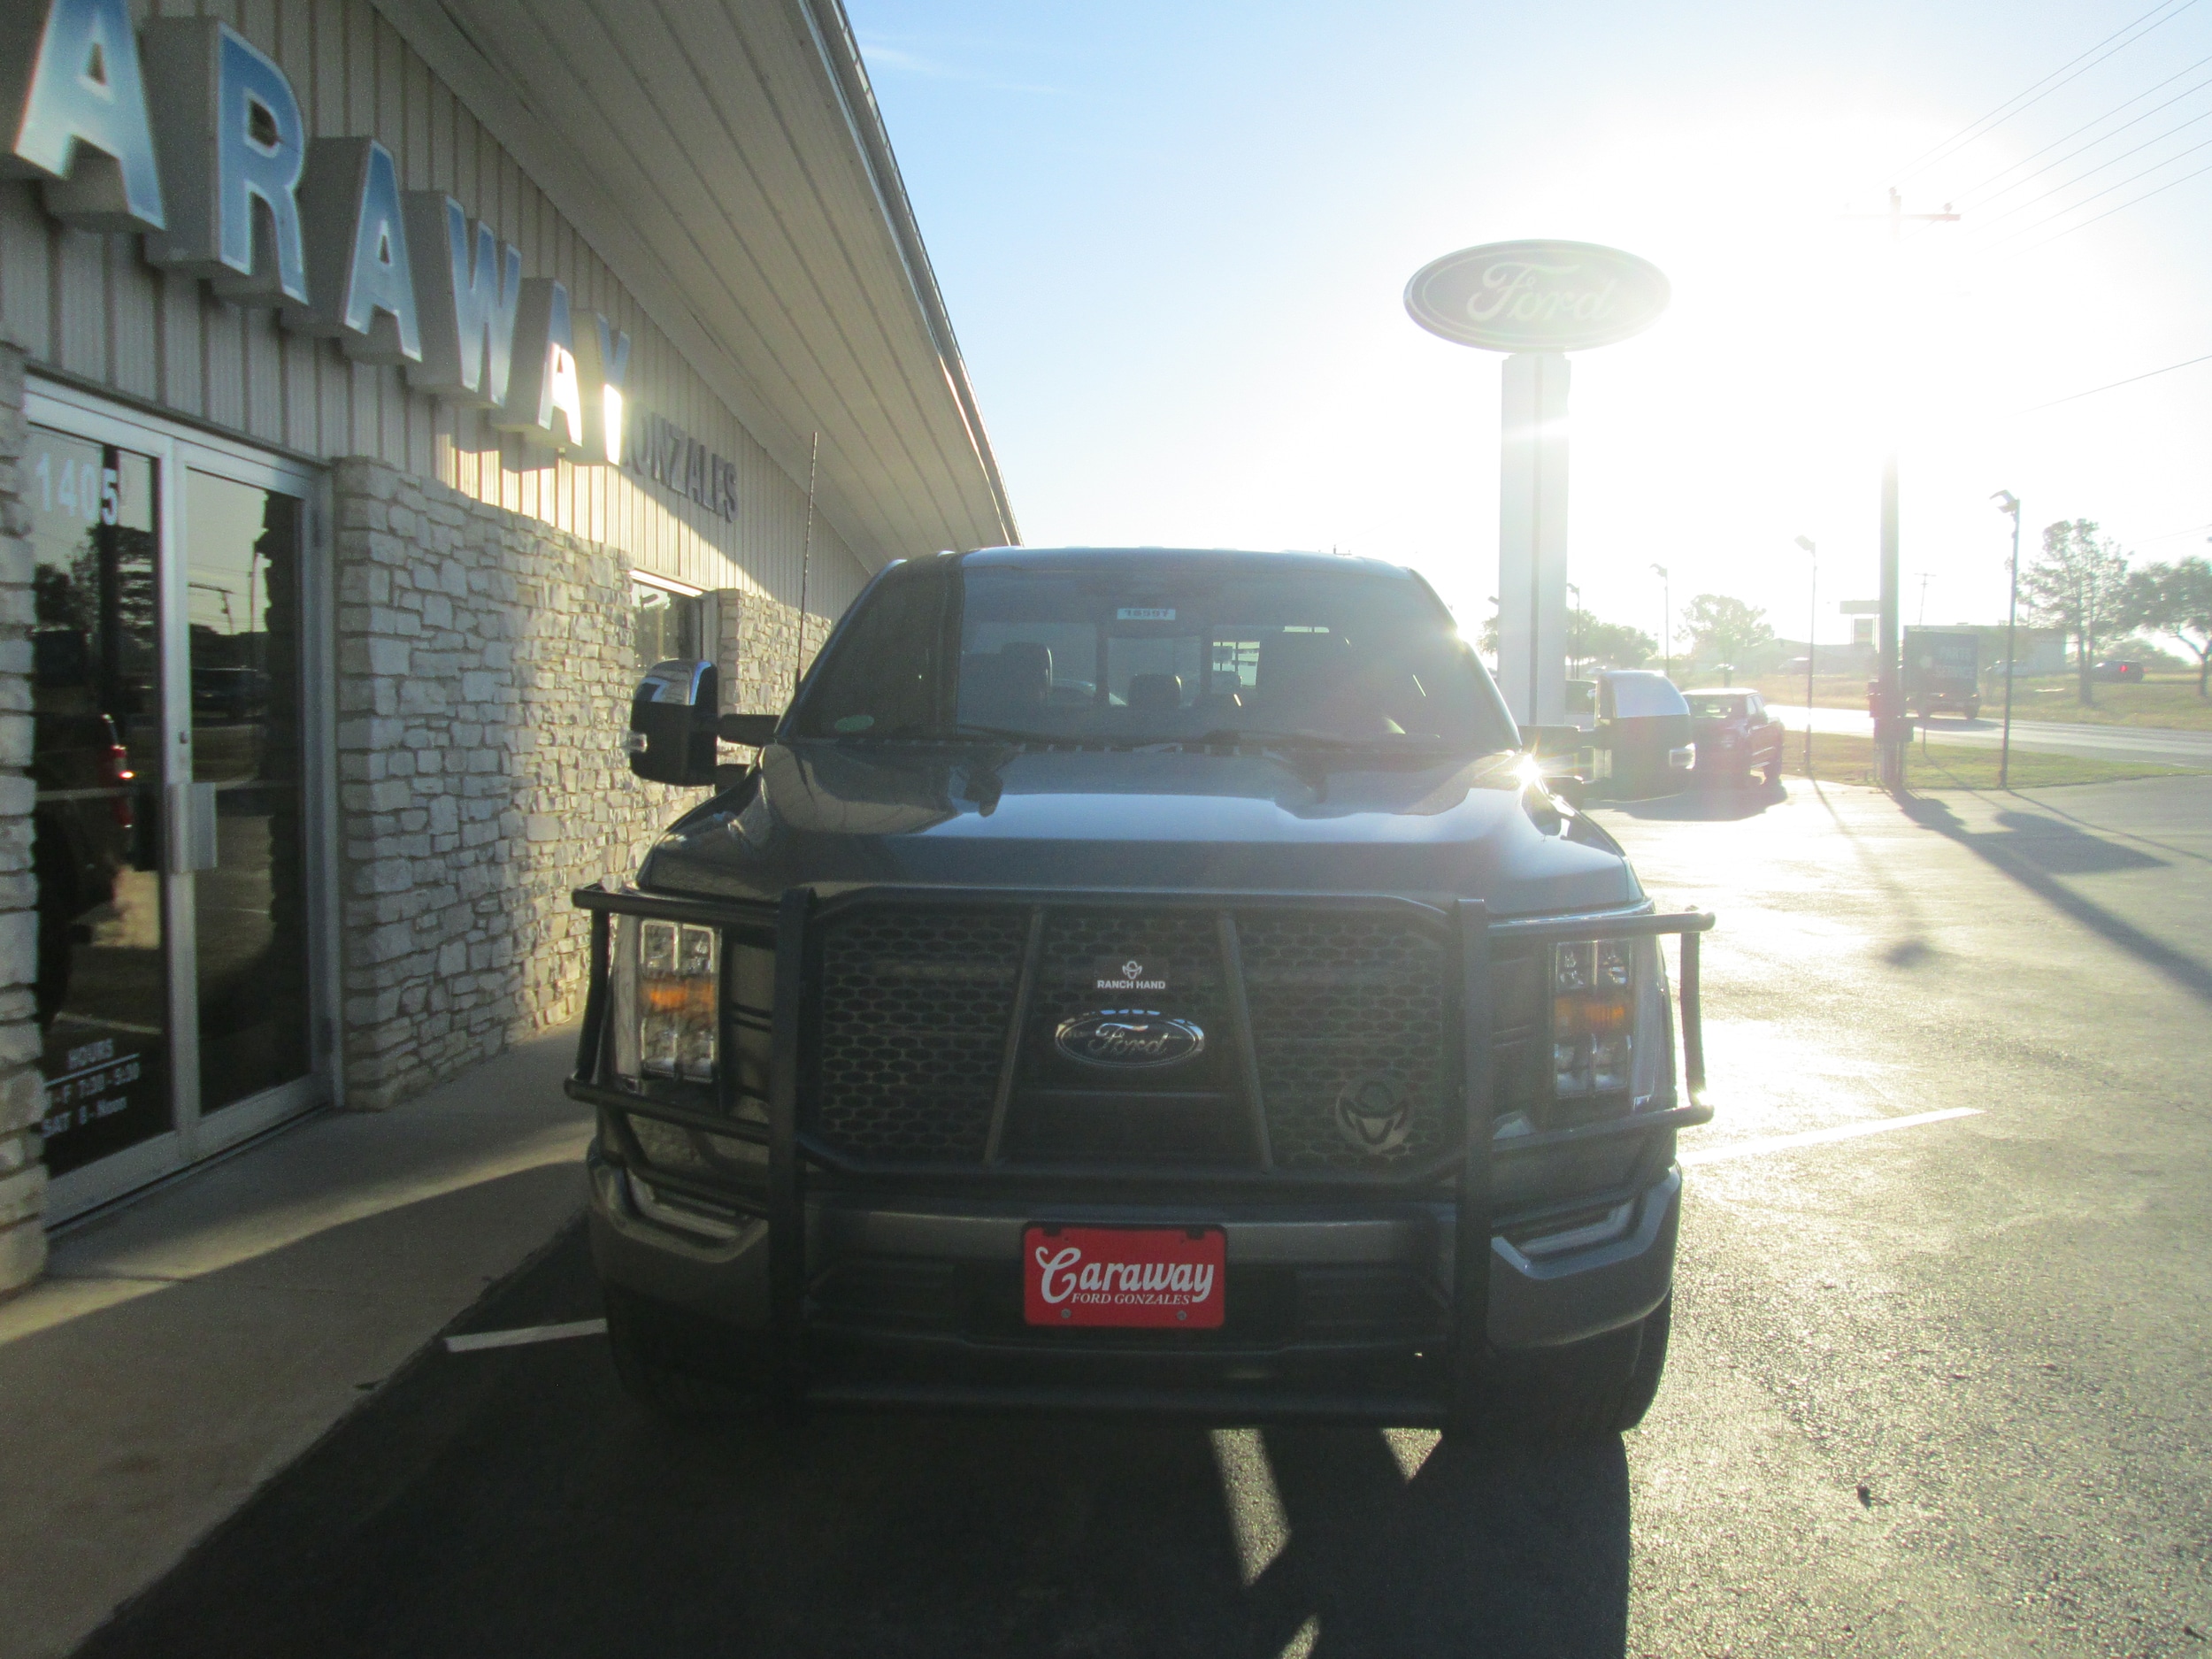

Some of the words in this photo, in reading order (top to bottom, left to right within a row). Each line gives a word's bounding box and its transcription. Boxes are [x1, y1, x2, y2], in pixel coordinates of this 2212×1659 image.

[1466, 261, 1618, 321] Ford
[621, 403, 738, 523] ONZALES
[35, 453, 119, 526] 1405
[1097, 980, 1133, 989] RANCH
[1136, 980, 1165, 989] HAND
[67, 1038, 114, 1071] HOURS
[1088, 1022, 1169, 1056] Ford
[1035, 1247, 1214, 1303] Caraway
[1071, 1293, 1111, 1304] FORD
[1114, 1294, 1190, 1305] GONZALES
